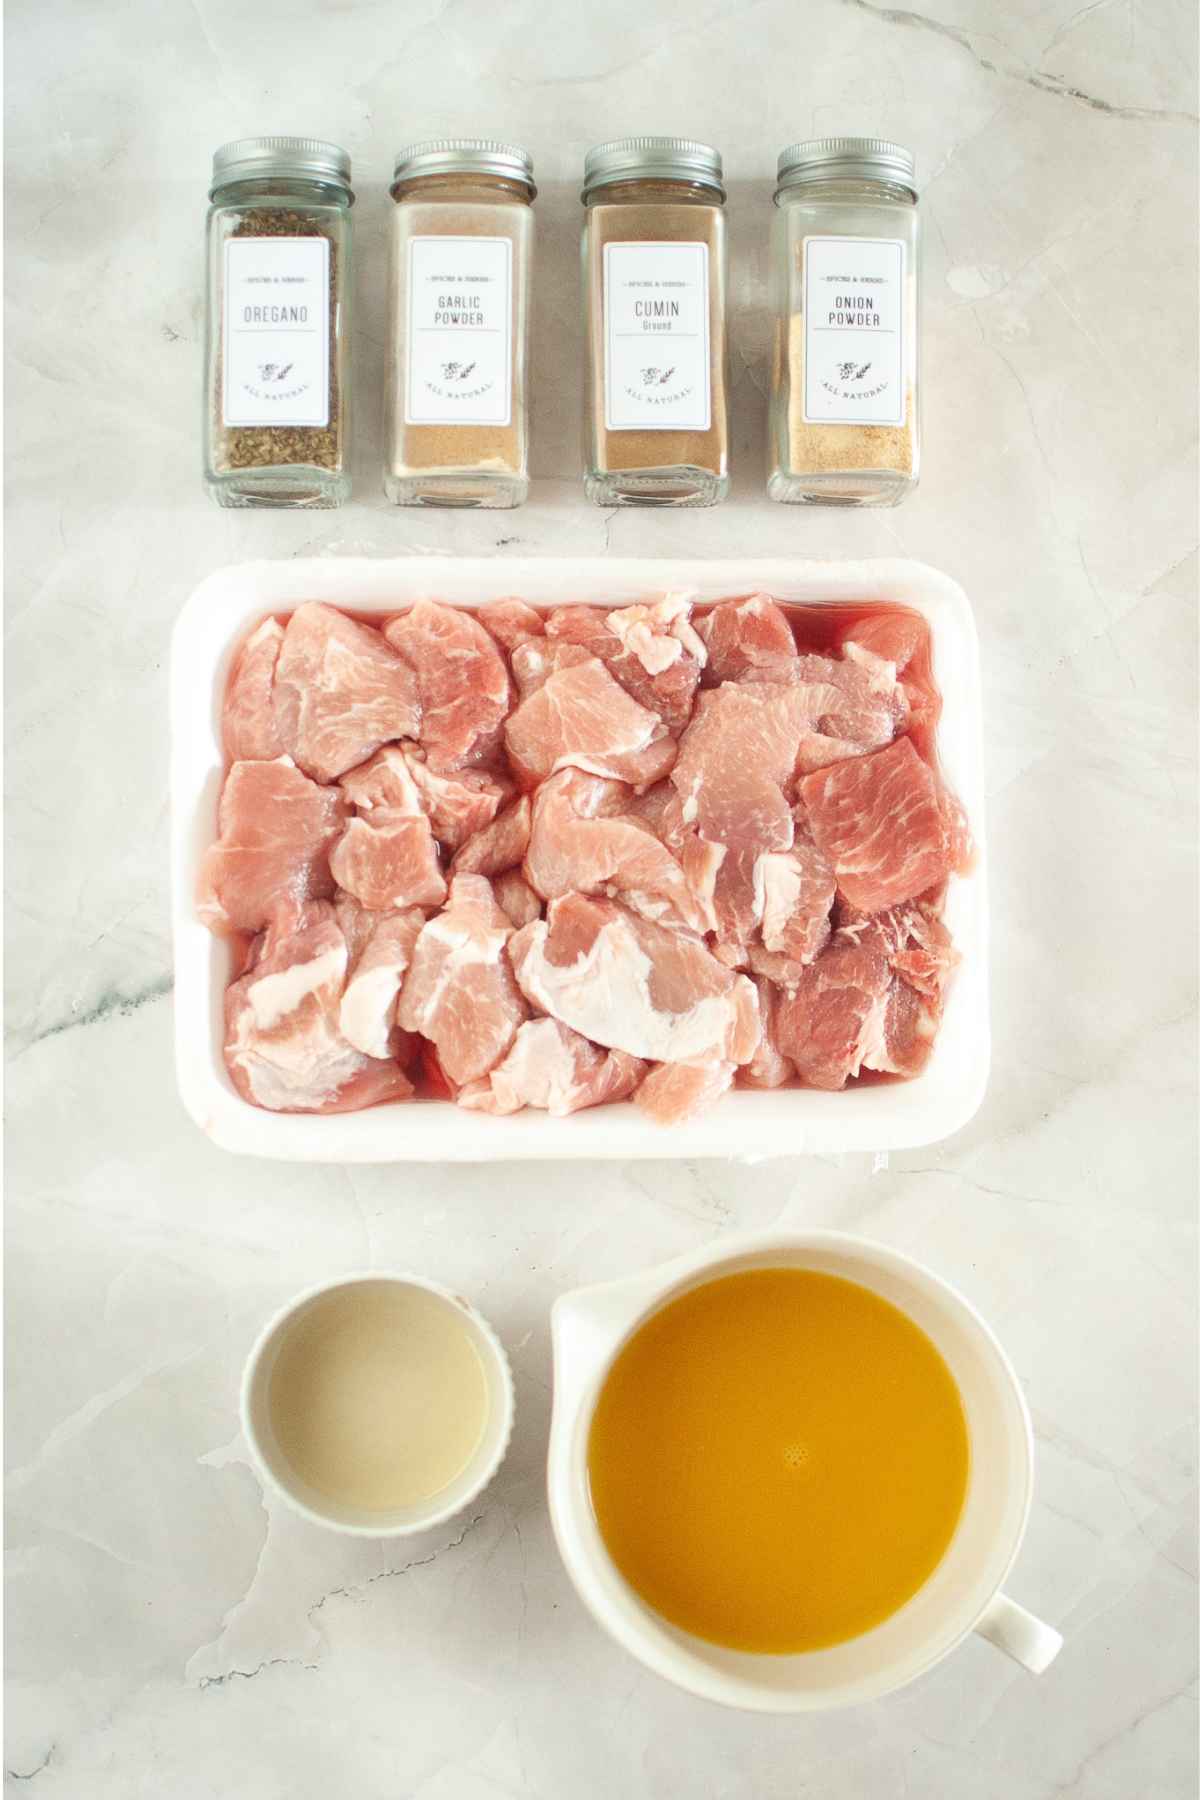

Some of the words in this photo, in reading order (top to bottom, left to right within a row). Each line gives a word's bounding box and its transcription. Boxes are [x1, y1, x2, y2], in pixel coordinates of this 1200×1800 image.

[438, 295, 481, 309] GARLIC
[634, 300, 680, 317] CUMIN
[835, 295, 873, 310] ONION
[243, 305, 308, 322] OREGANO
[434, 312, 484, 325] POWDER
[828, 312, 880, 326] POWDER
[642, 320, 673, 331] Ground
[822, 381, 839, 396] ALL
[842, 382, 889, 401] NATURAL
